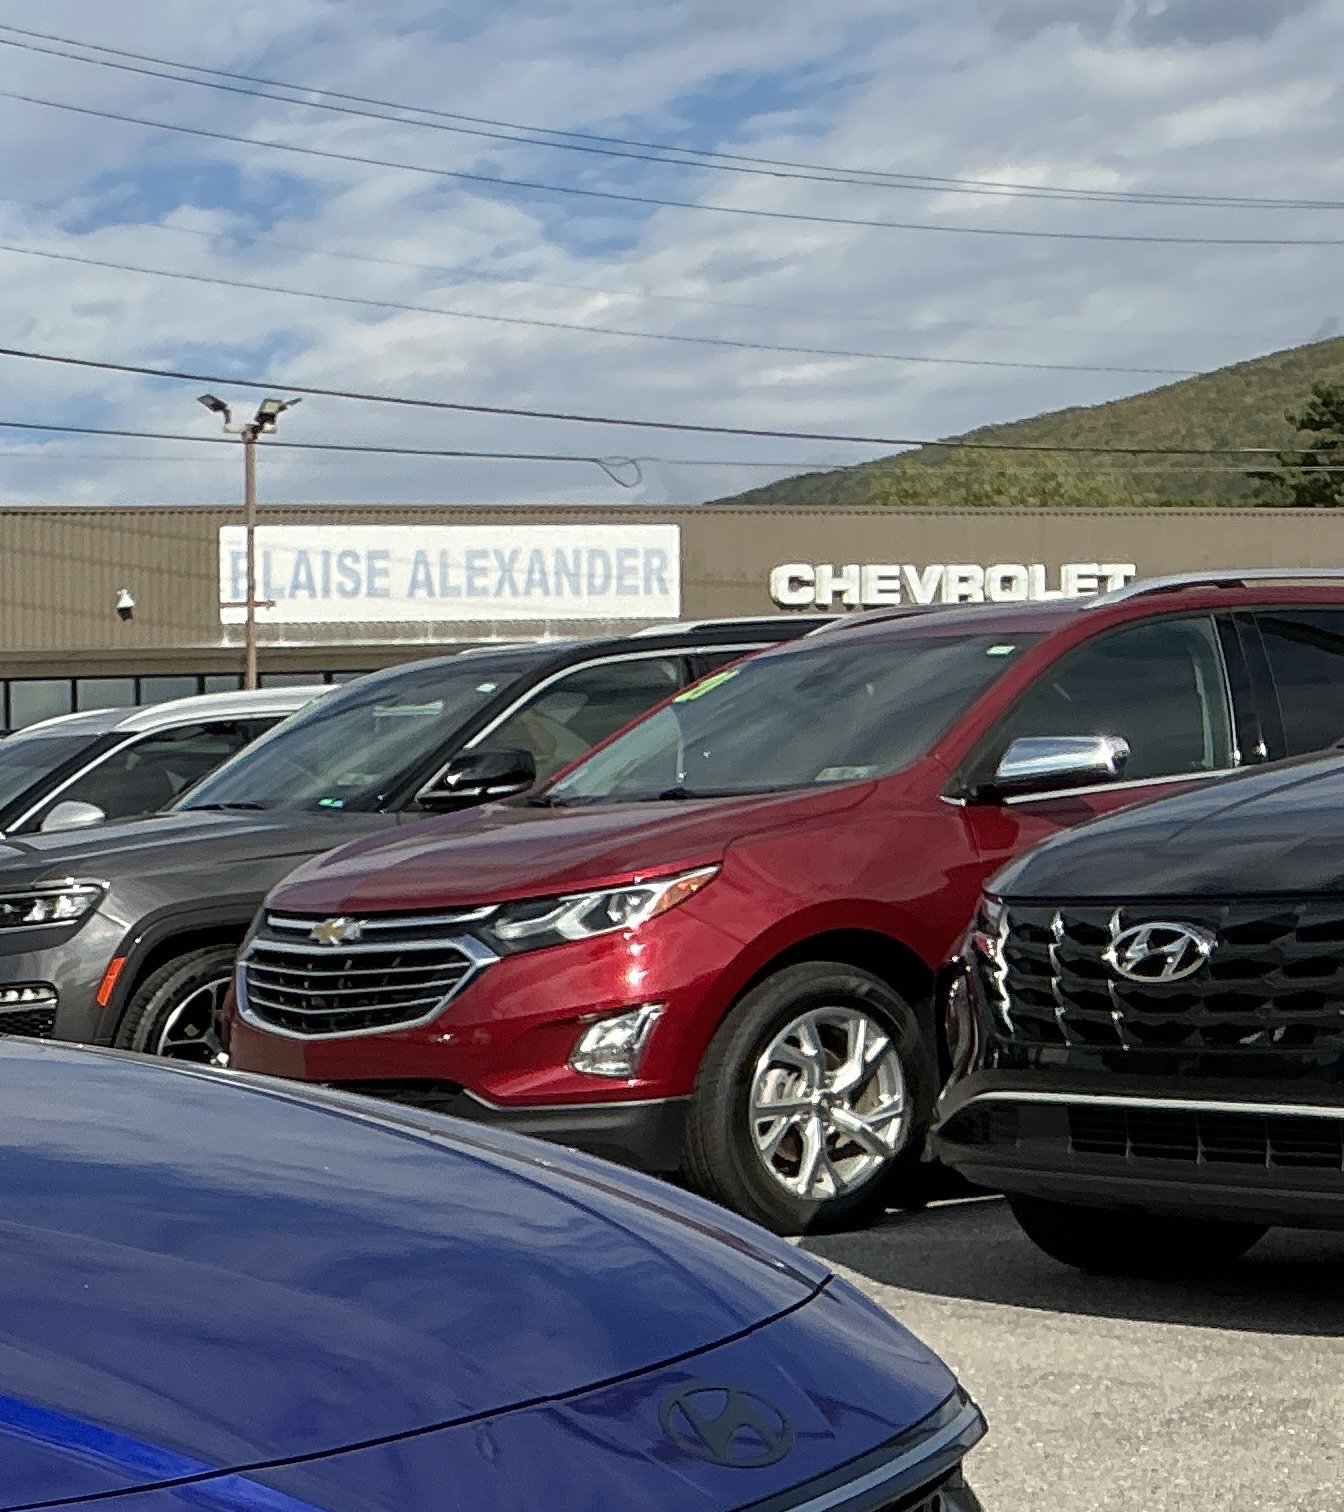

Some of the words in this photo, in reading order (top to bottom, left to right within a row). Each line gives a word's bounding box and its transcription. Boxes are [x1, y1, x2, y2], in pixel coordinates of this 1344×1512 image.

[229, 548, 392, 601] BLAISE
[405, 547, 672, 597] ALEXANDER
[769, 563, 1137, 606] CHEVROLET
